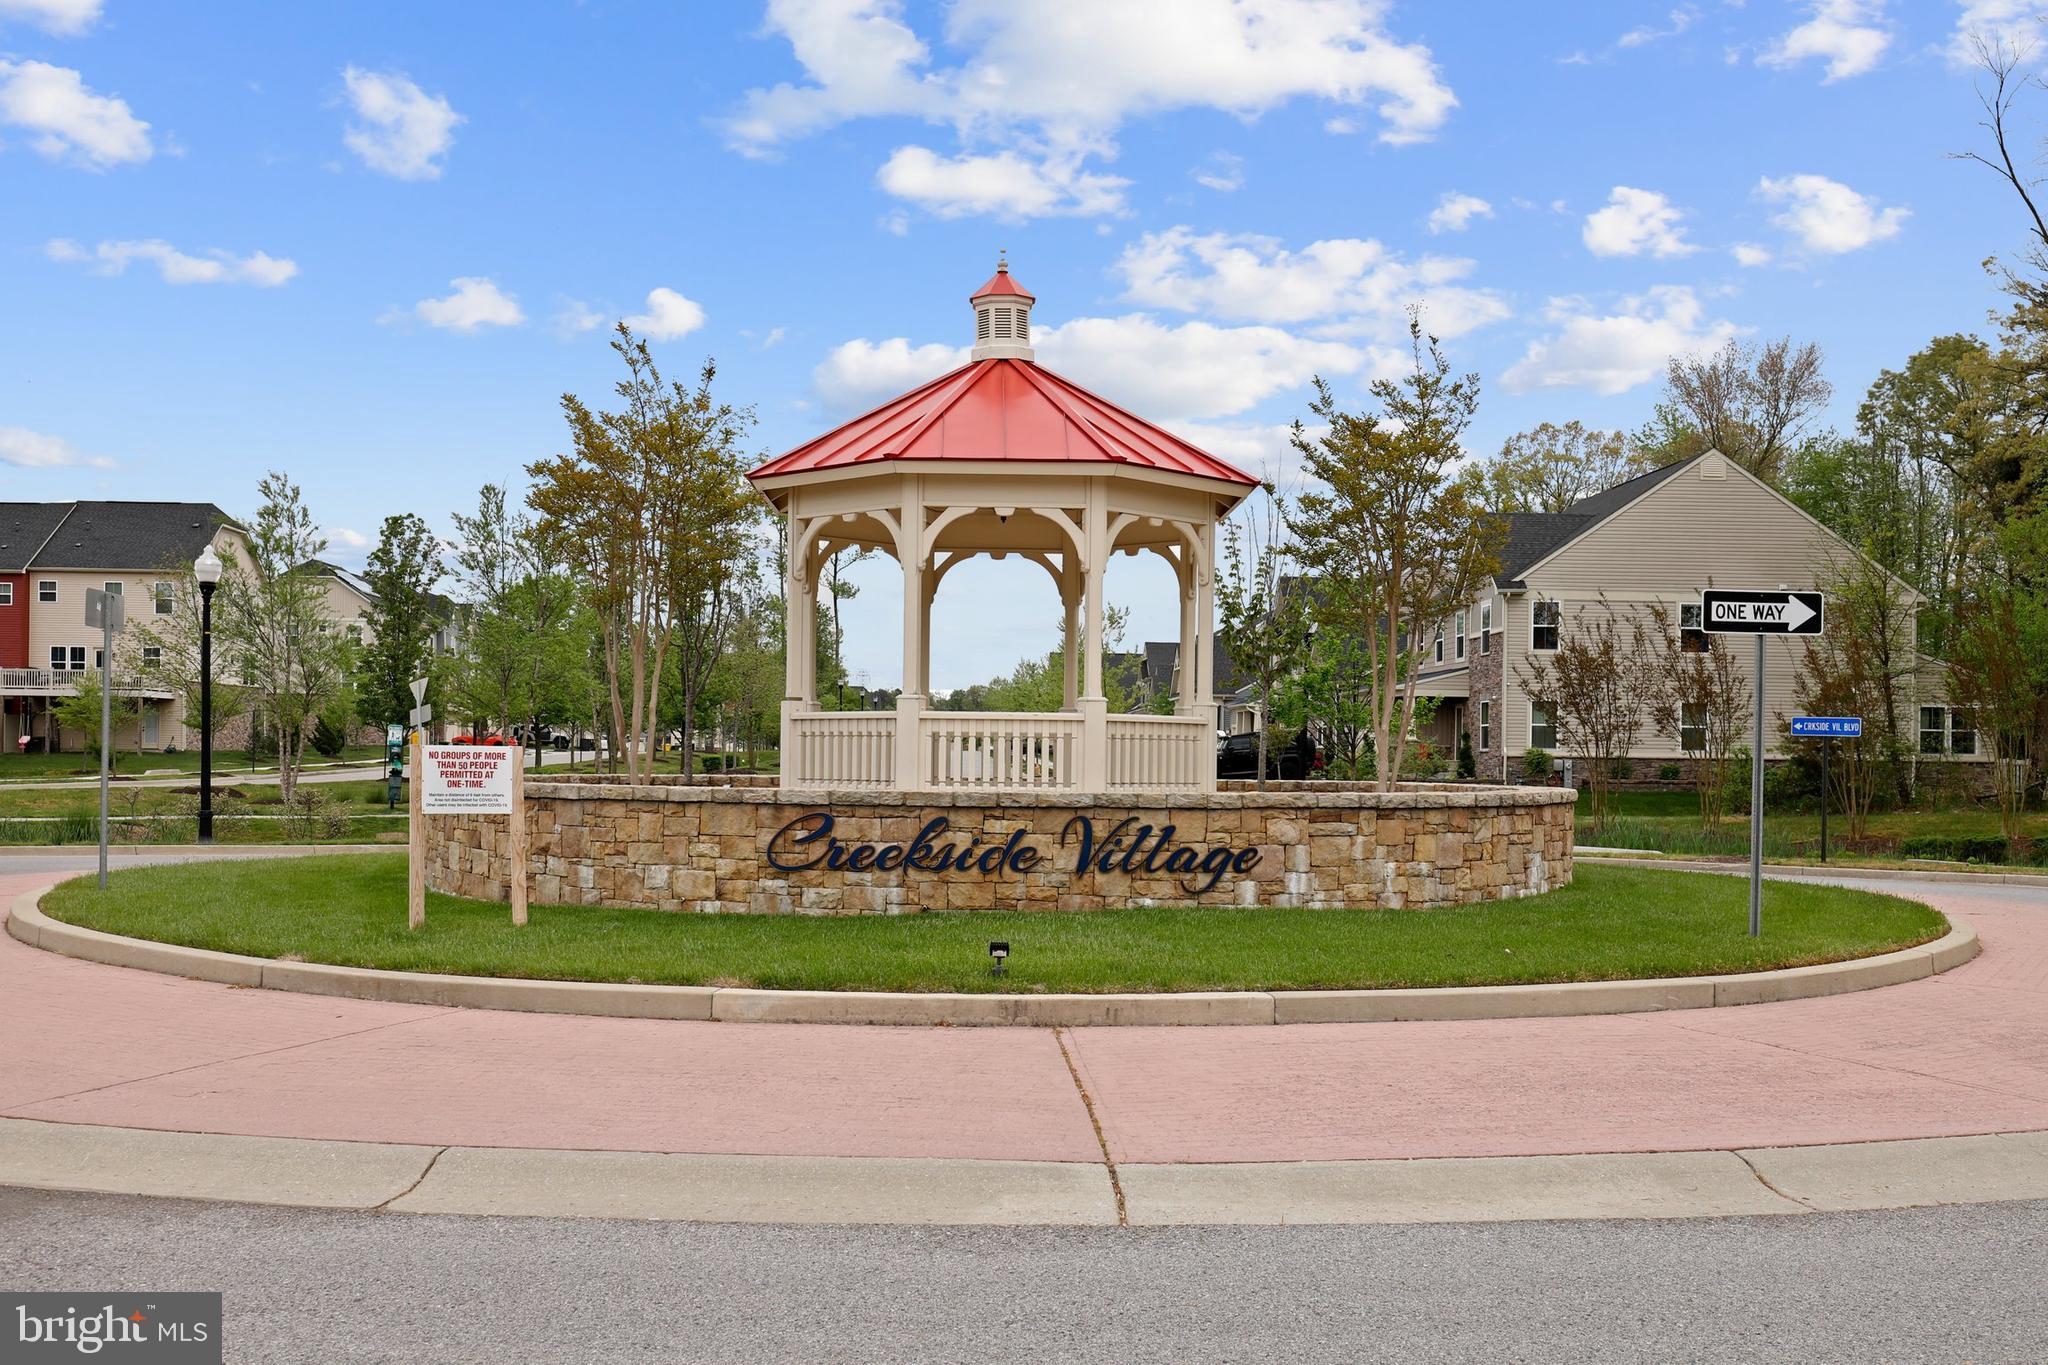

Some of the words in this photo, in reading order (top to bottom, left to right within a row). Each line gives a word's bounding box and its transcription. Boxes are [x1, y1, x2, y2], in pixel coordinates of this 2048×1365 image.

[1715, 603, 1747, 620] ONE
[1752, 604, 1786, 621] WAY
[1803, 722, 1830, 731] CRKSIDE
[1832, 722, 1842, 731] VIL
[1843, 722, 1860, 731] BLVD
[428, 751, 439, 760] NO
[440, 751, 471, 760] GROUPS
[472, 751, 483, 760] OF
[484, 752, 507, 761] MORE
[436, 760, 457, 769] THAN
[458, 761, 468, 770] 50
[469, 761, 498, 770] PEOPLE
[439, 770, 483, 779] PERMITTED
[484, 771, 495, 779] AT
[446, 779, 487, 789] ONE-TIME.
[766, 811, 1041, 876] Creekside
[1061, 815, 1264, 894] Village
